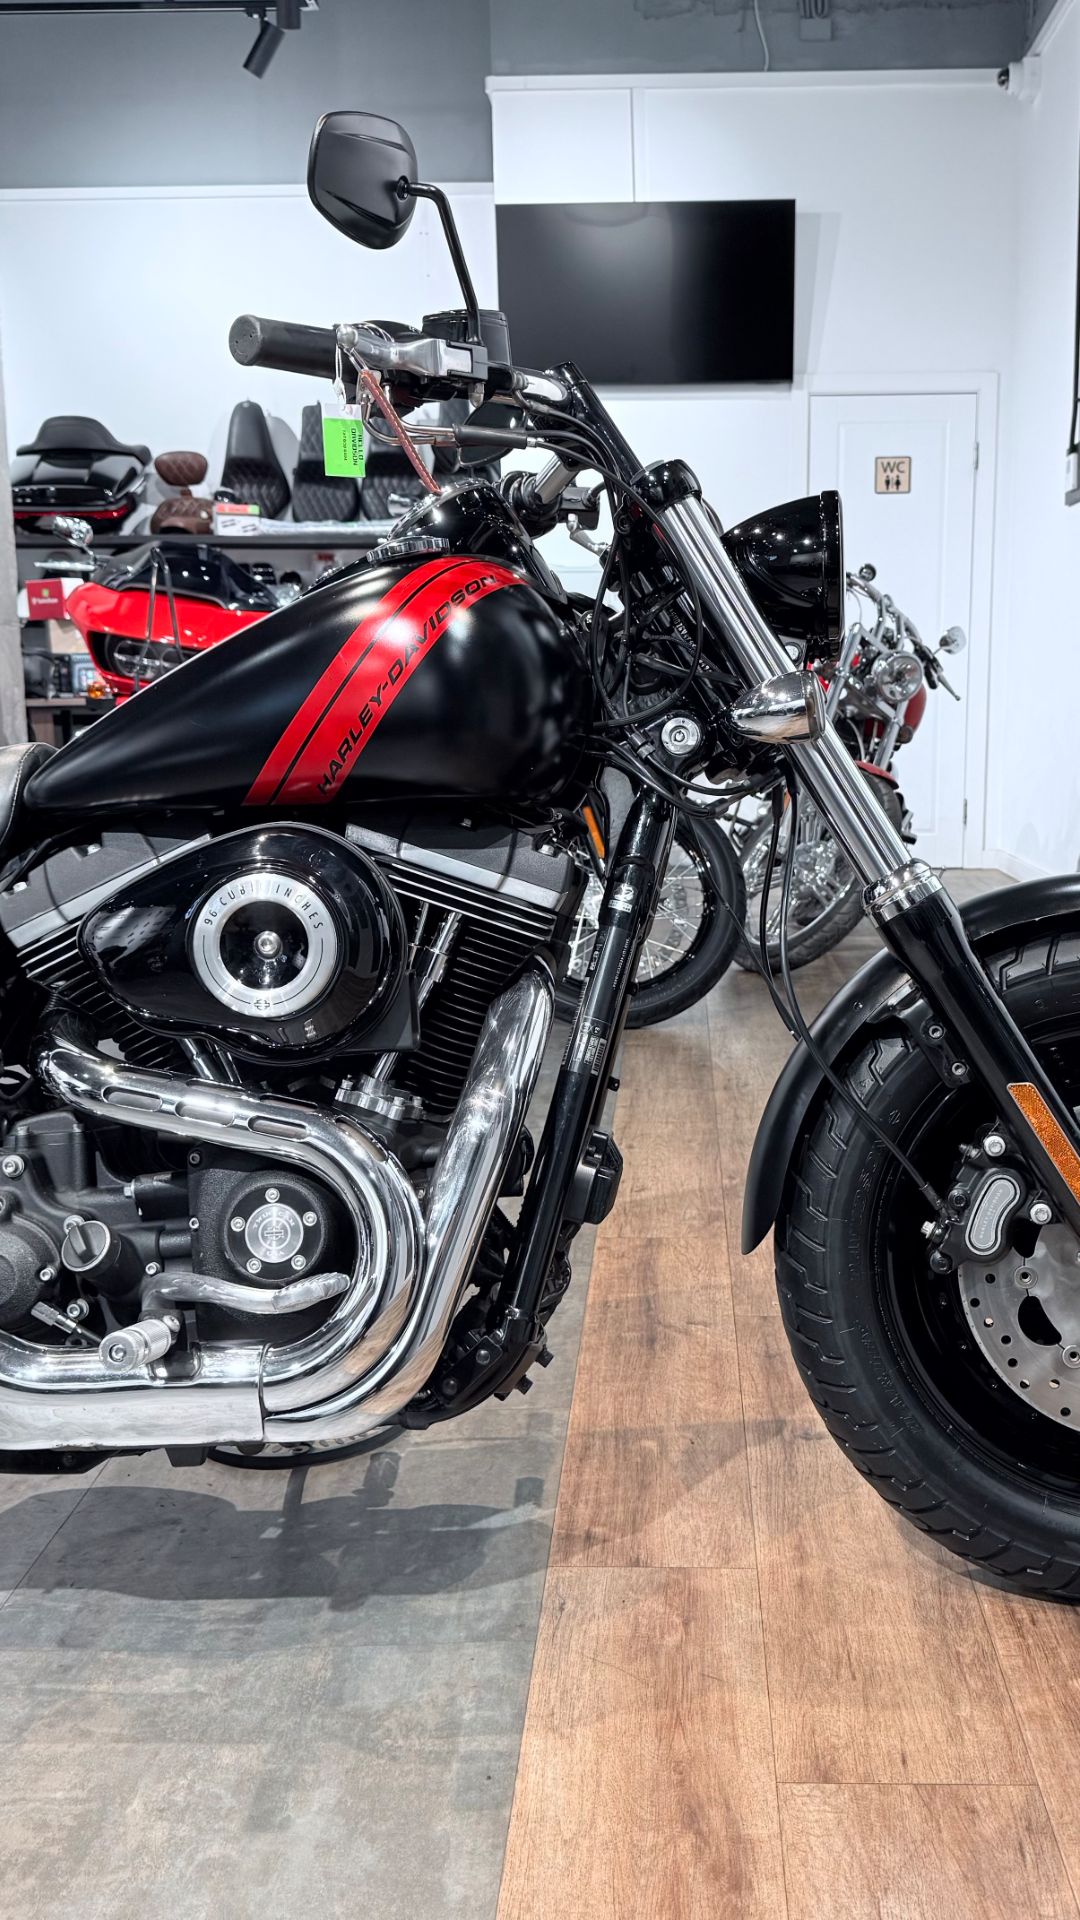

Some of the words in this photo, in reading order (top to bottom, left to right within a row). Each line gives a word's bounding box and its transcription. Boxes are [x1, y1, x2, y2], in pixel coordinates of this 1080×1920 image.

[880, 460, 906, 474] WC
[316, 574, 497, 796] HARLEY-DAVIDSON
[204, 909, 218, 925] 96
[275, 884, 324, 930] INCHES
